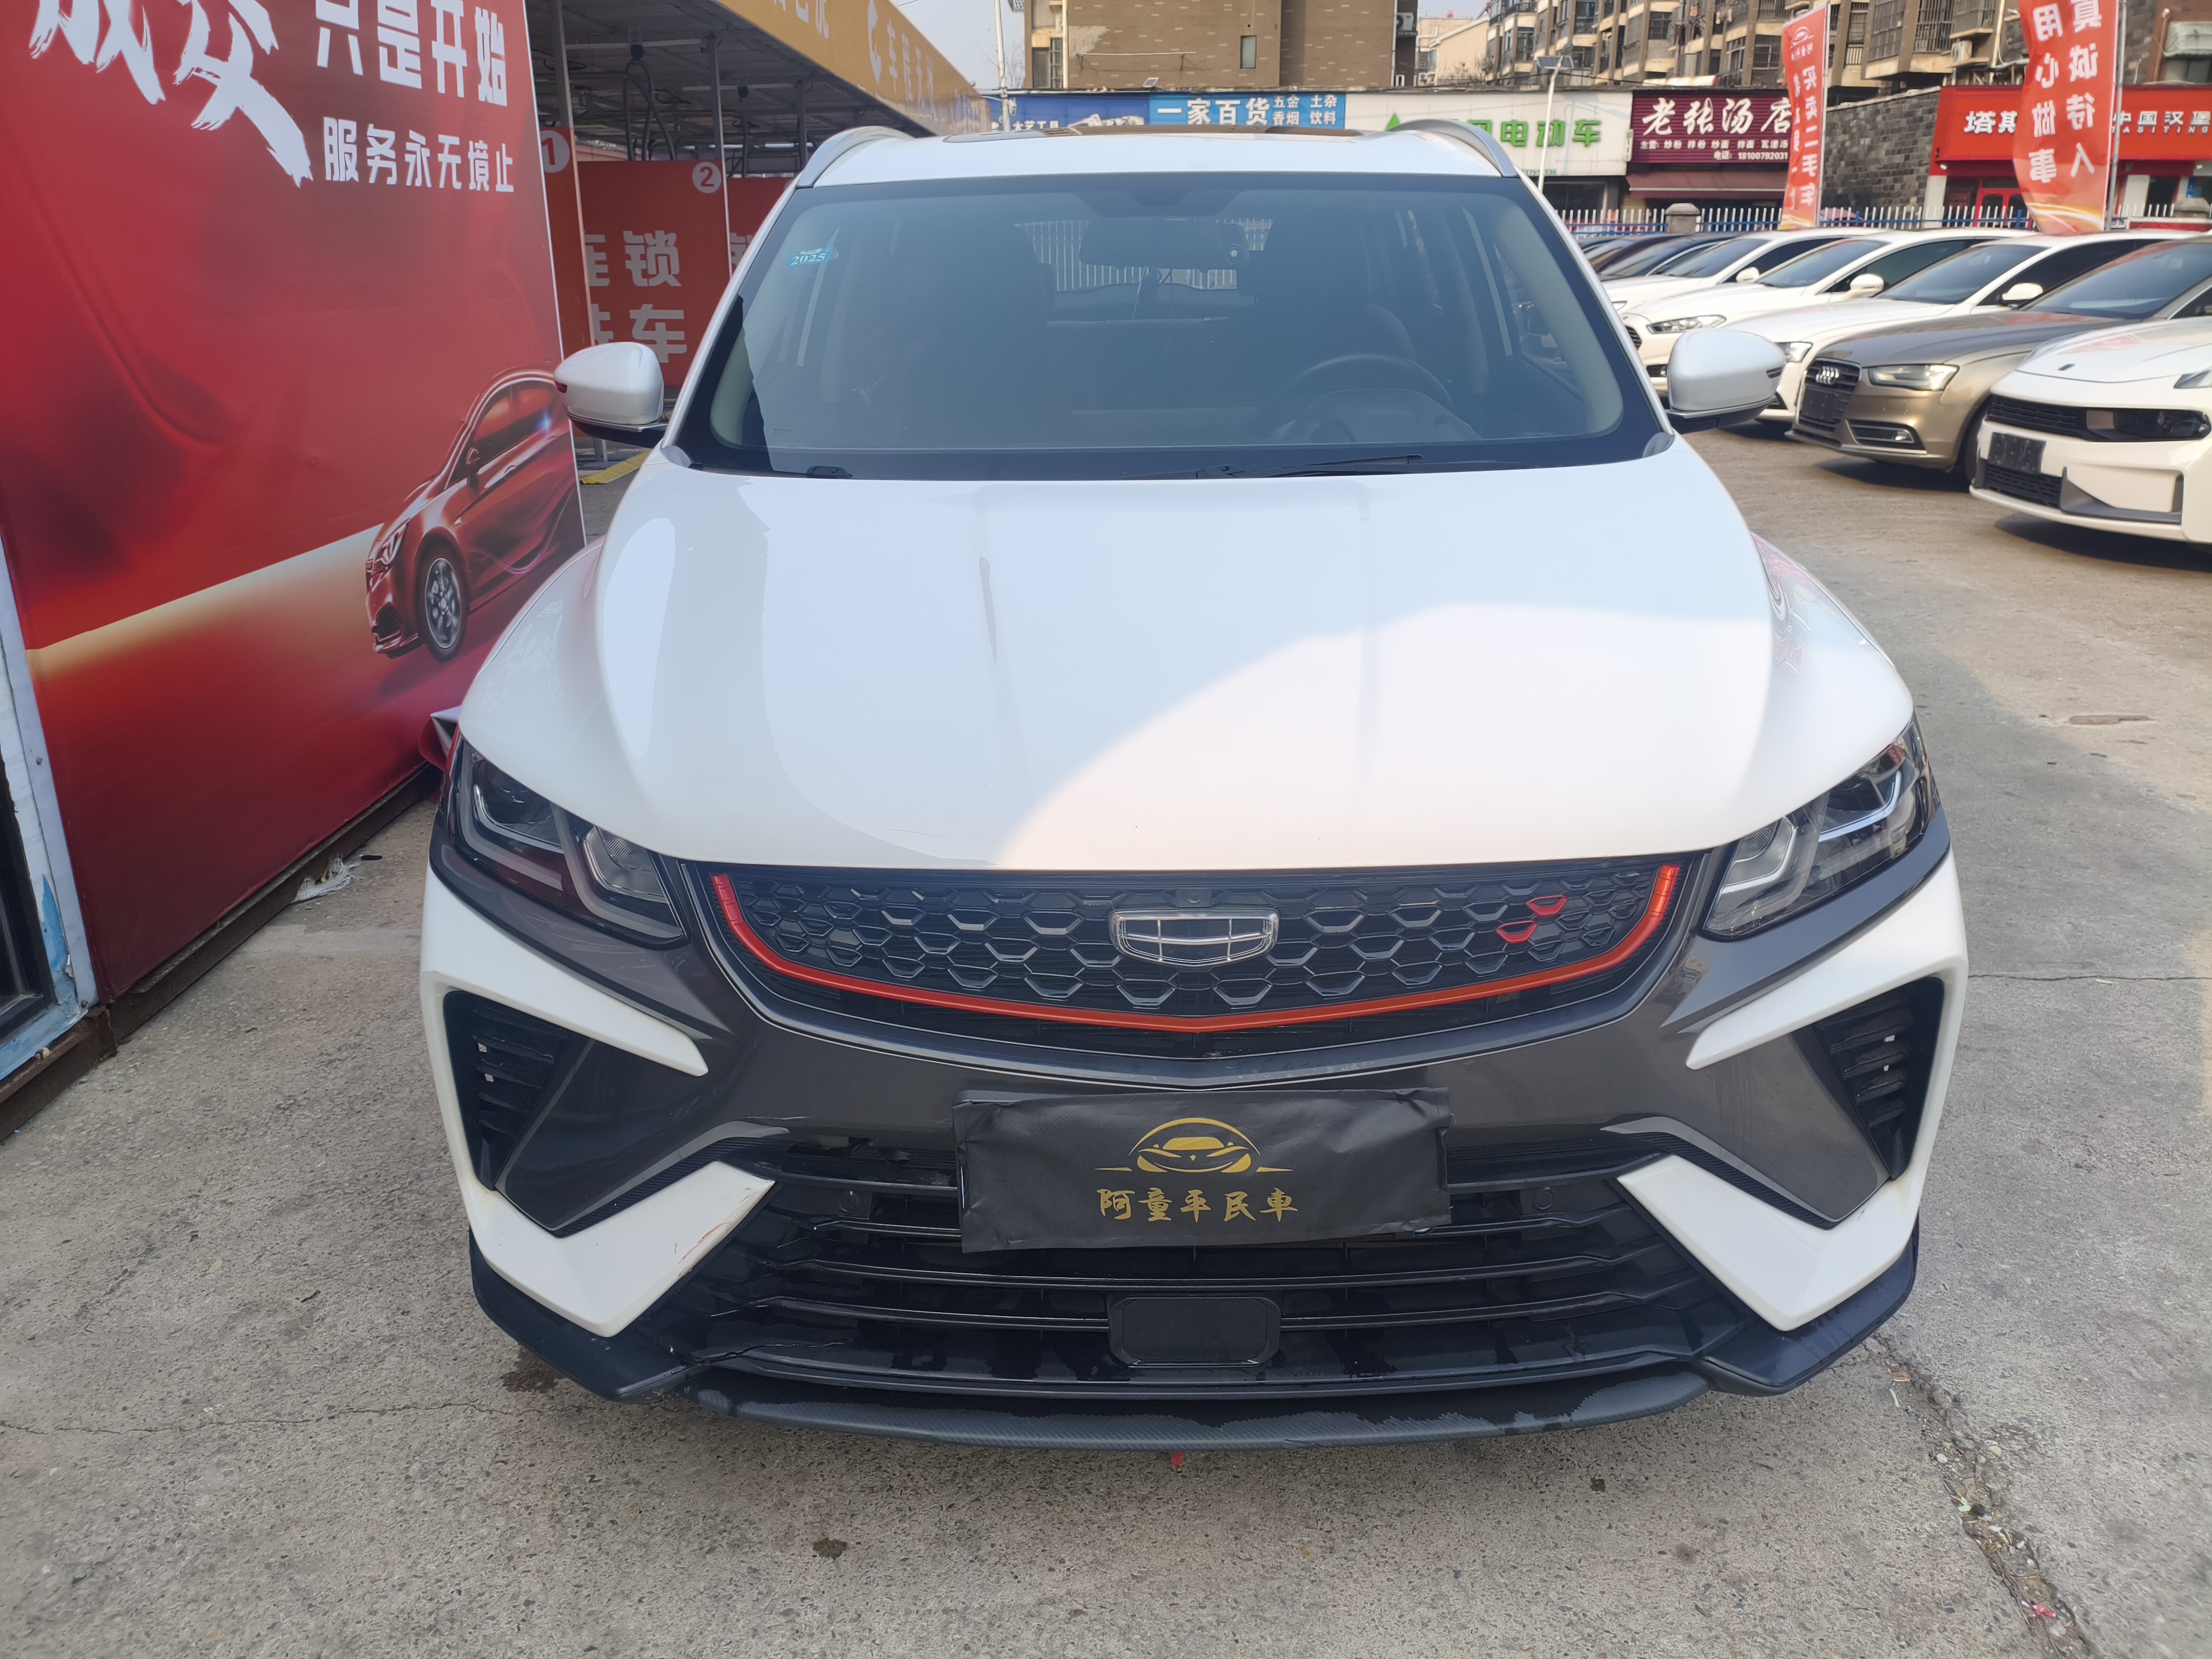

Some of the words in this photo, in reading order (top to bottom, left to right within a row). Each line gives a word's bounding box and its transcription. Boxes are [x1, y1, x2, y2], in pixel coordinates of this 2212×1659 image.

[315, 0, 507, 106] 只是开始
[1157, 97, 1270, 126] 一家百货
[1272, 95, 1300, 108] 五金
[1310, 95, 1338, 108] 土杂
[1272, 111, 1300, 126] 香烟
[1310, 111, 1337, 126] 饮料
[1642, 97, 1792, 136] 老张汤店
[2112, 111, 2211, 126] 中国汉堡
[323, 117, 514, 192] 服务永无境止
[699, 166, 714, 187] 2
[790, 253, 827, 266] 2025
